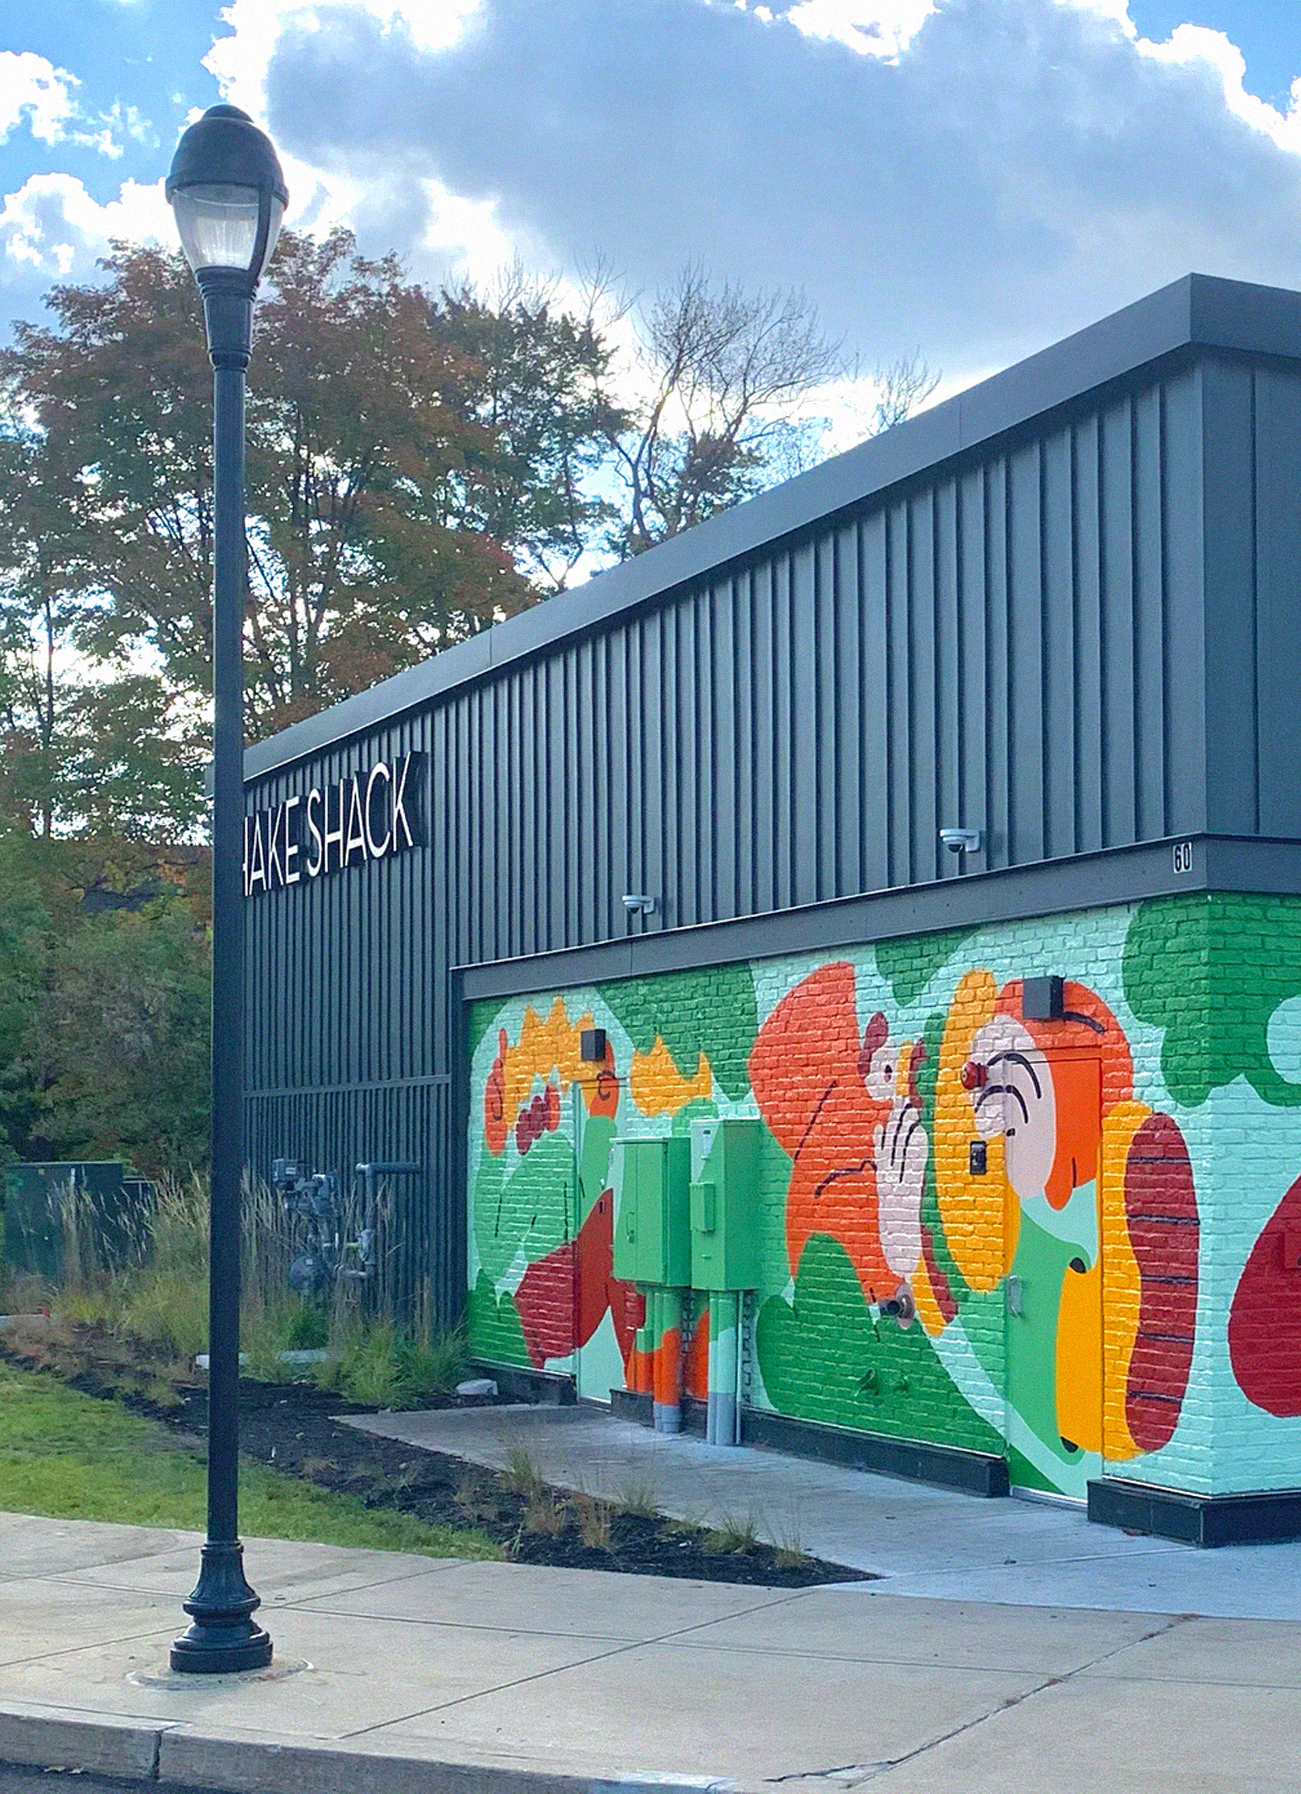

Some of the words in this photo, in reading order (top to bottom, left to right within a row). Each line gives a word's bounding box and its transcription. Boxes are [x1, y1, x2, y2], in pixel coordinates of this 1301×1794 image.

[243, 796, 300, 896] AKE
[307, 751, 414, 877] SHACK
[1174, 843, 1190, 872] 60
